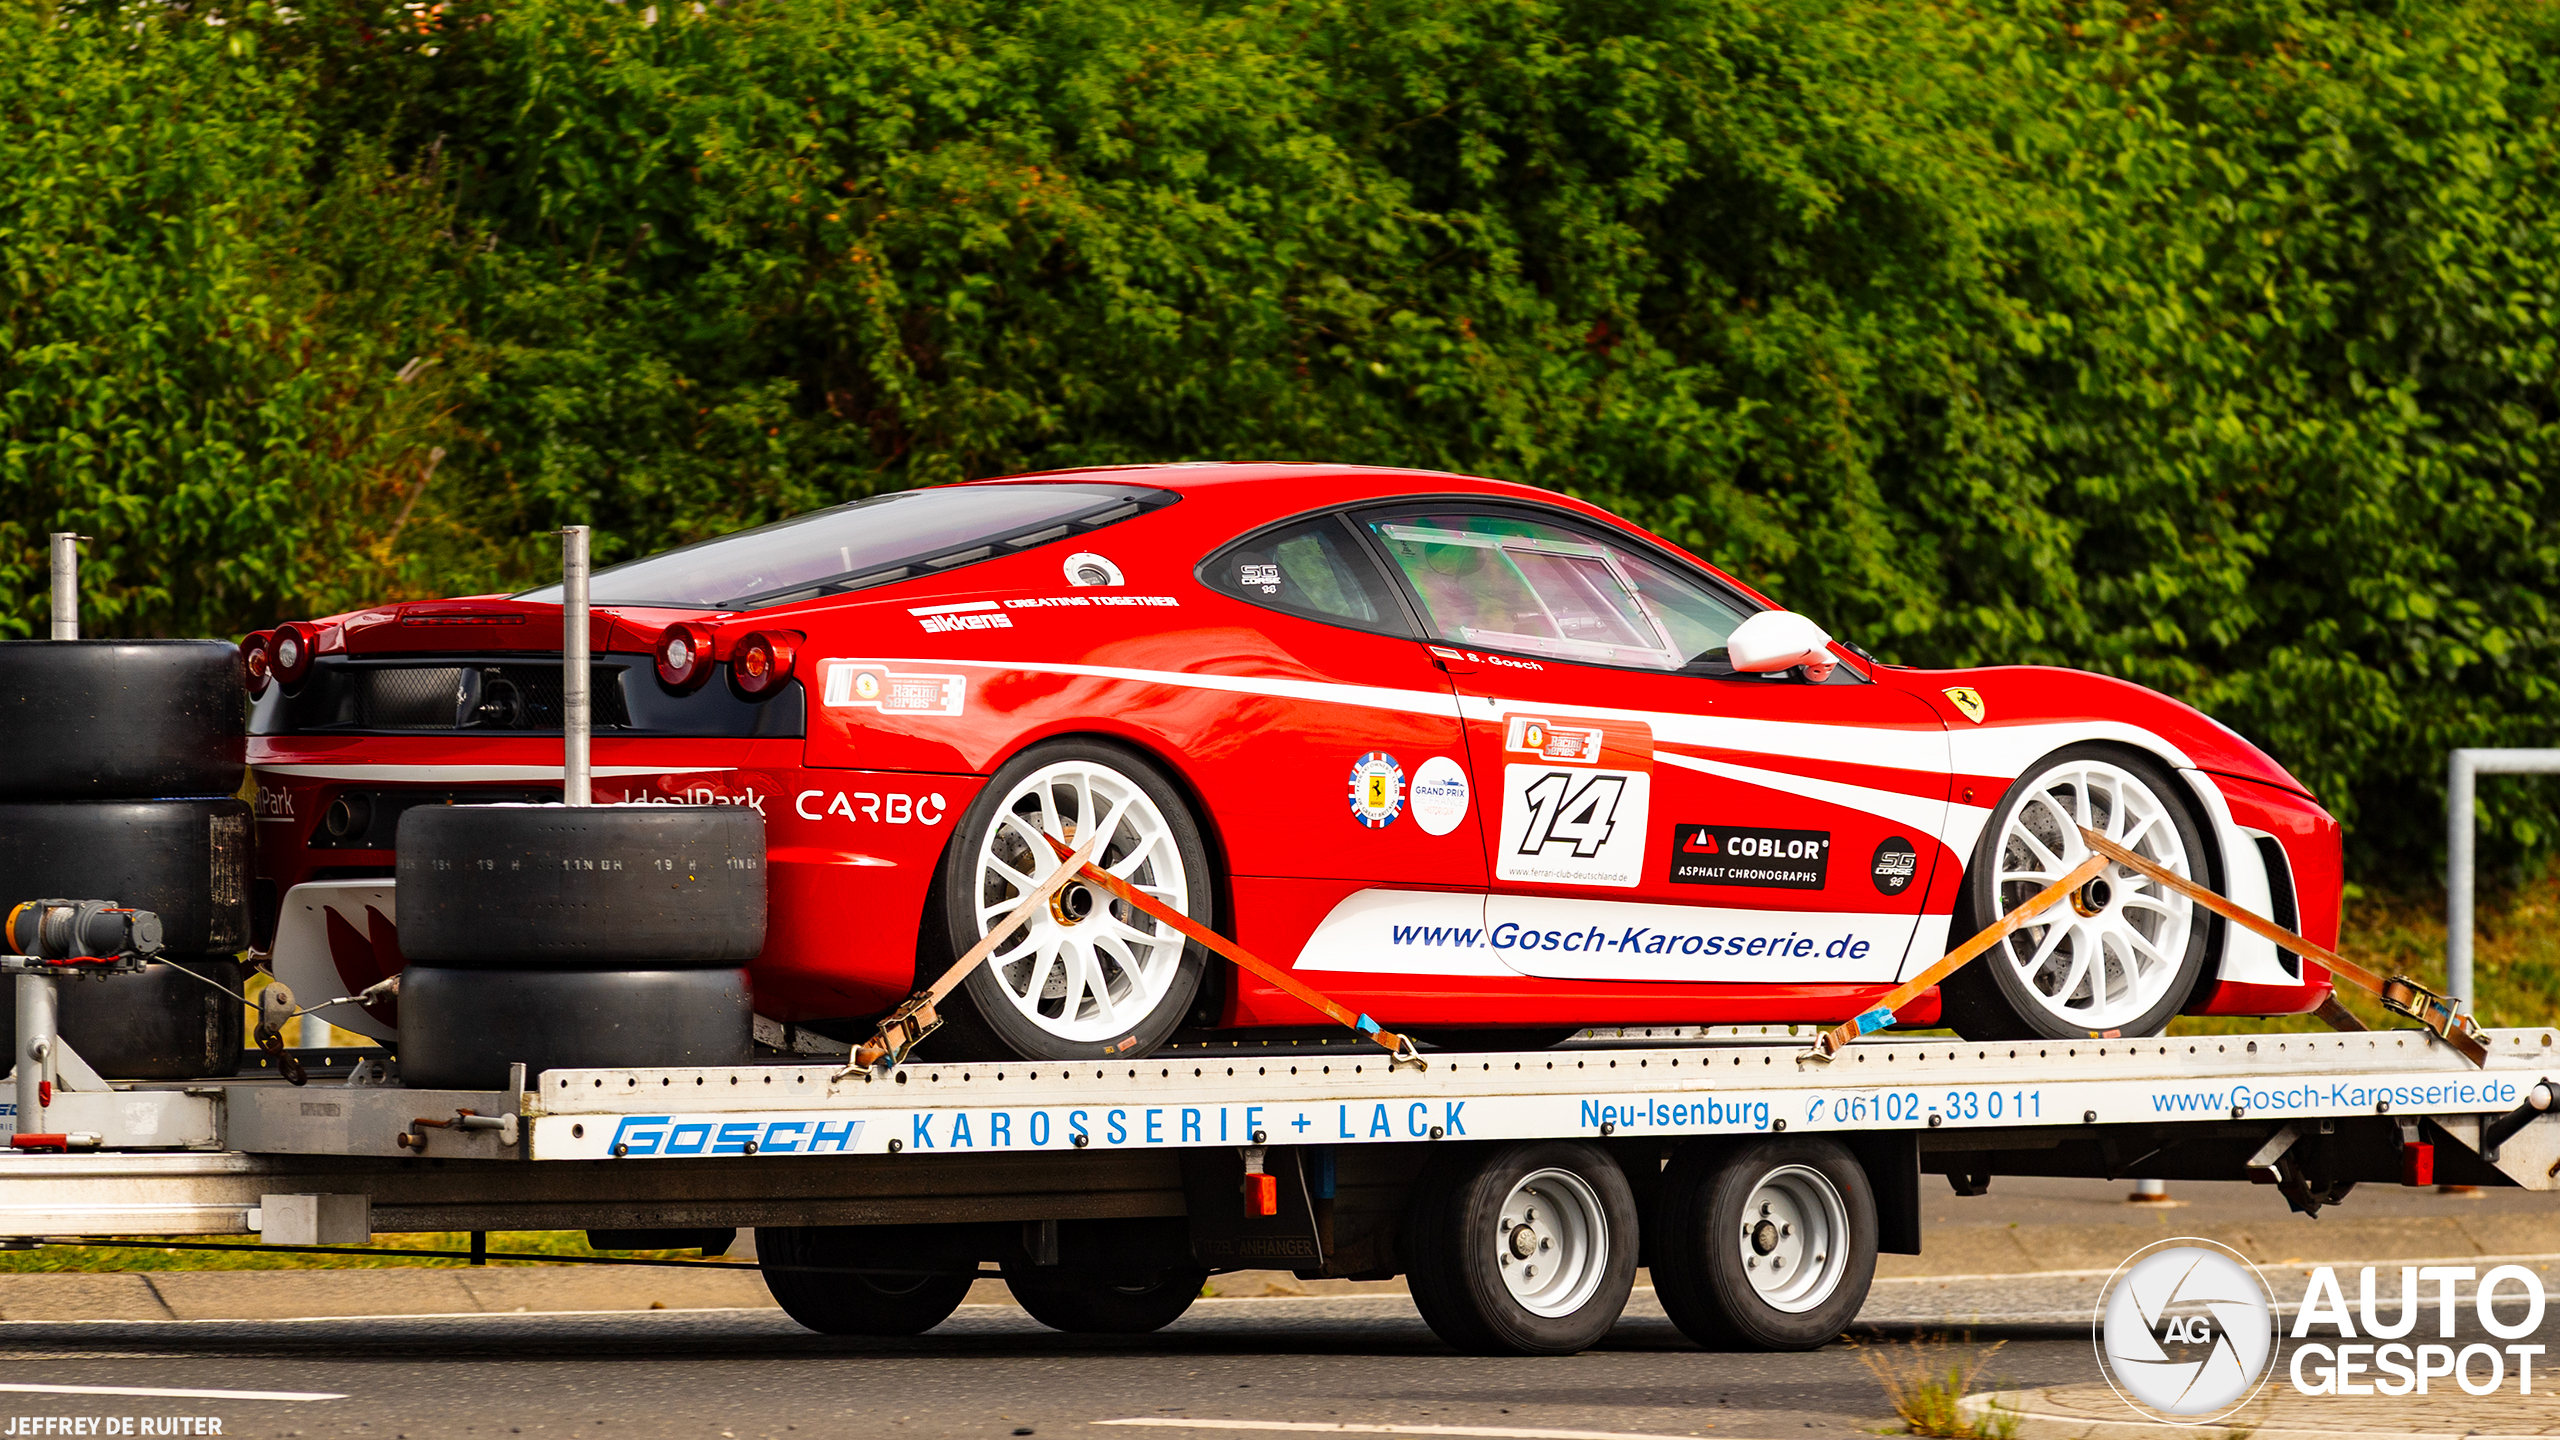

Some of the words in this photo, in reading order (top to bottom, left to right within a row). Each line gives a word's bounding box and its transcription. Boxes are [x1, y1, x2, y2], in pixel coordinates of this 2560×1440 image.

[1241, 564, 1278, 578] SG
[1003, 596, 1091, 609] CREATING
[1088, 596, 1180, 607] TOGETHER
[1466, 652, 1486, 663] S.
[1487, 656, 1544, 671] Gosch
[886, 694, 930, 708] Series
[892, 684, 940, 702] Racing
[1545, 743, 1576, 757] Series
[1550, 735, 1583, 752] Racing
[1415, 786, 1444, 796] GRAND
[1446, 788, 1465, 798] PRIX
[1429, 796, 1465, 807] FRANCE
[1517, 772, 1628, 859] 14
[1727, 836, 1820, 860] COBLOR
[1879, 851, 1917, 868] SG
[1508, 867, 1628, 882] www.ferrari-club-deutschland.de
[1678, 866, 1725, 878] ASPHALT
[1728, 868, 1817, 883] CHRONOGRAPHS
[1875, 867, 1914, 876] CORSE
[1392, 922, 1870, 959] www.Gosch-Karosserie.de
[2151, 1079, 2517, 1113] www.Gosch-Karosserie.de
[1580, 1097, 1770, 1131] Neu-Isenburg
[1833, 1092, 1920, 1123] 06102
[1945, 1091, 1979, 1119] 33
[913, 1106, 1264, 1149] KAROSSERIE
[1338, 1101, 1467, 1139] LACK
[1238, 1236, 1315, 1256] ANHÄNGER
